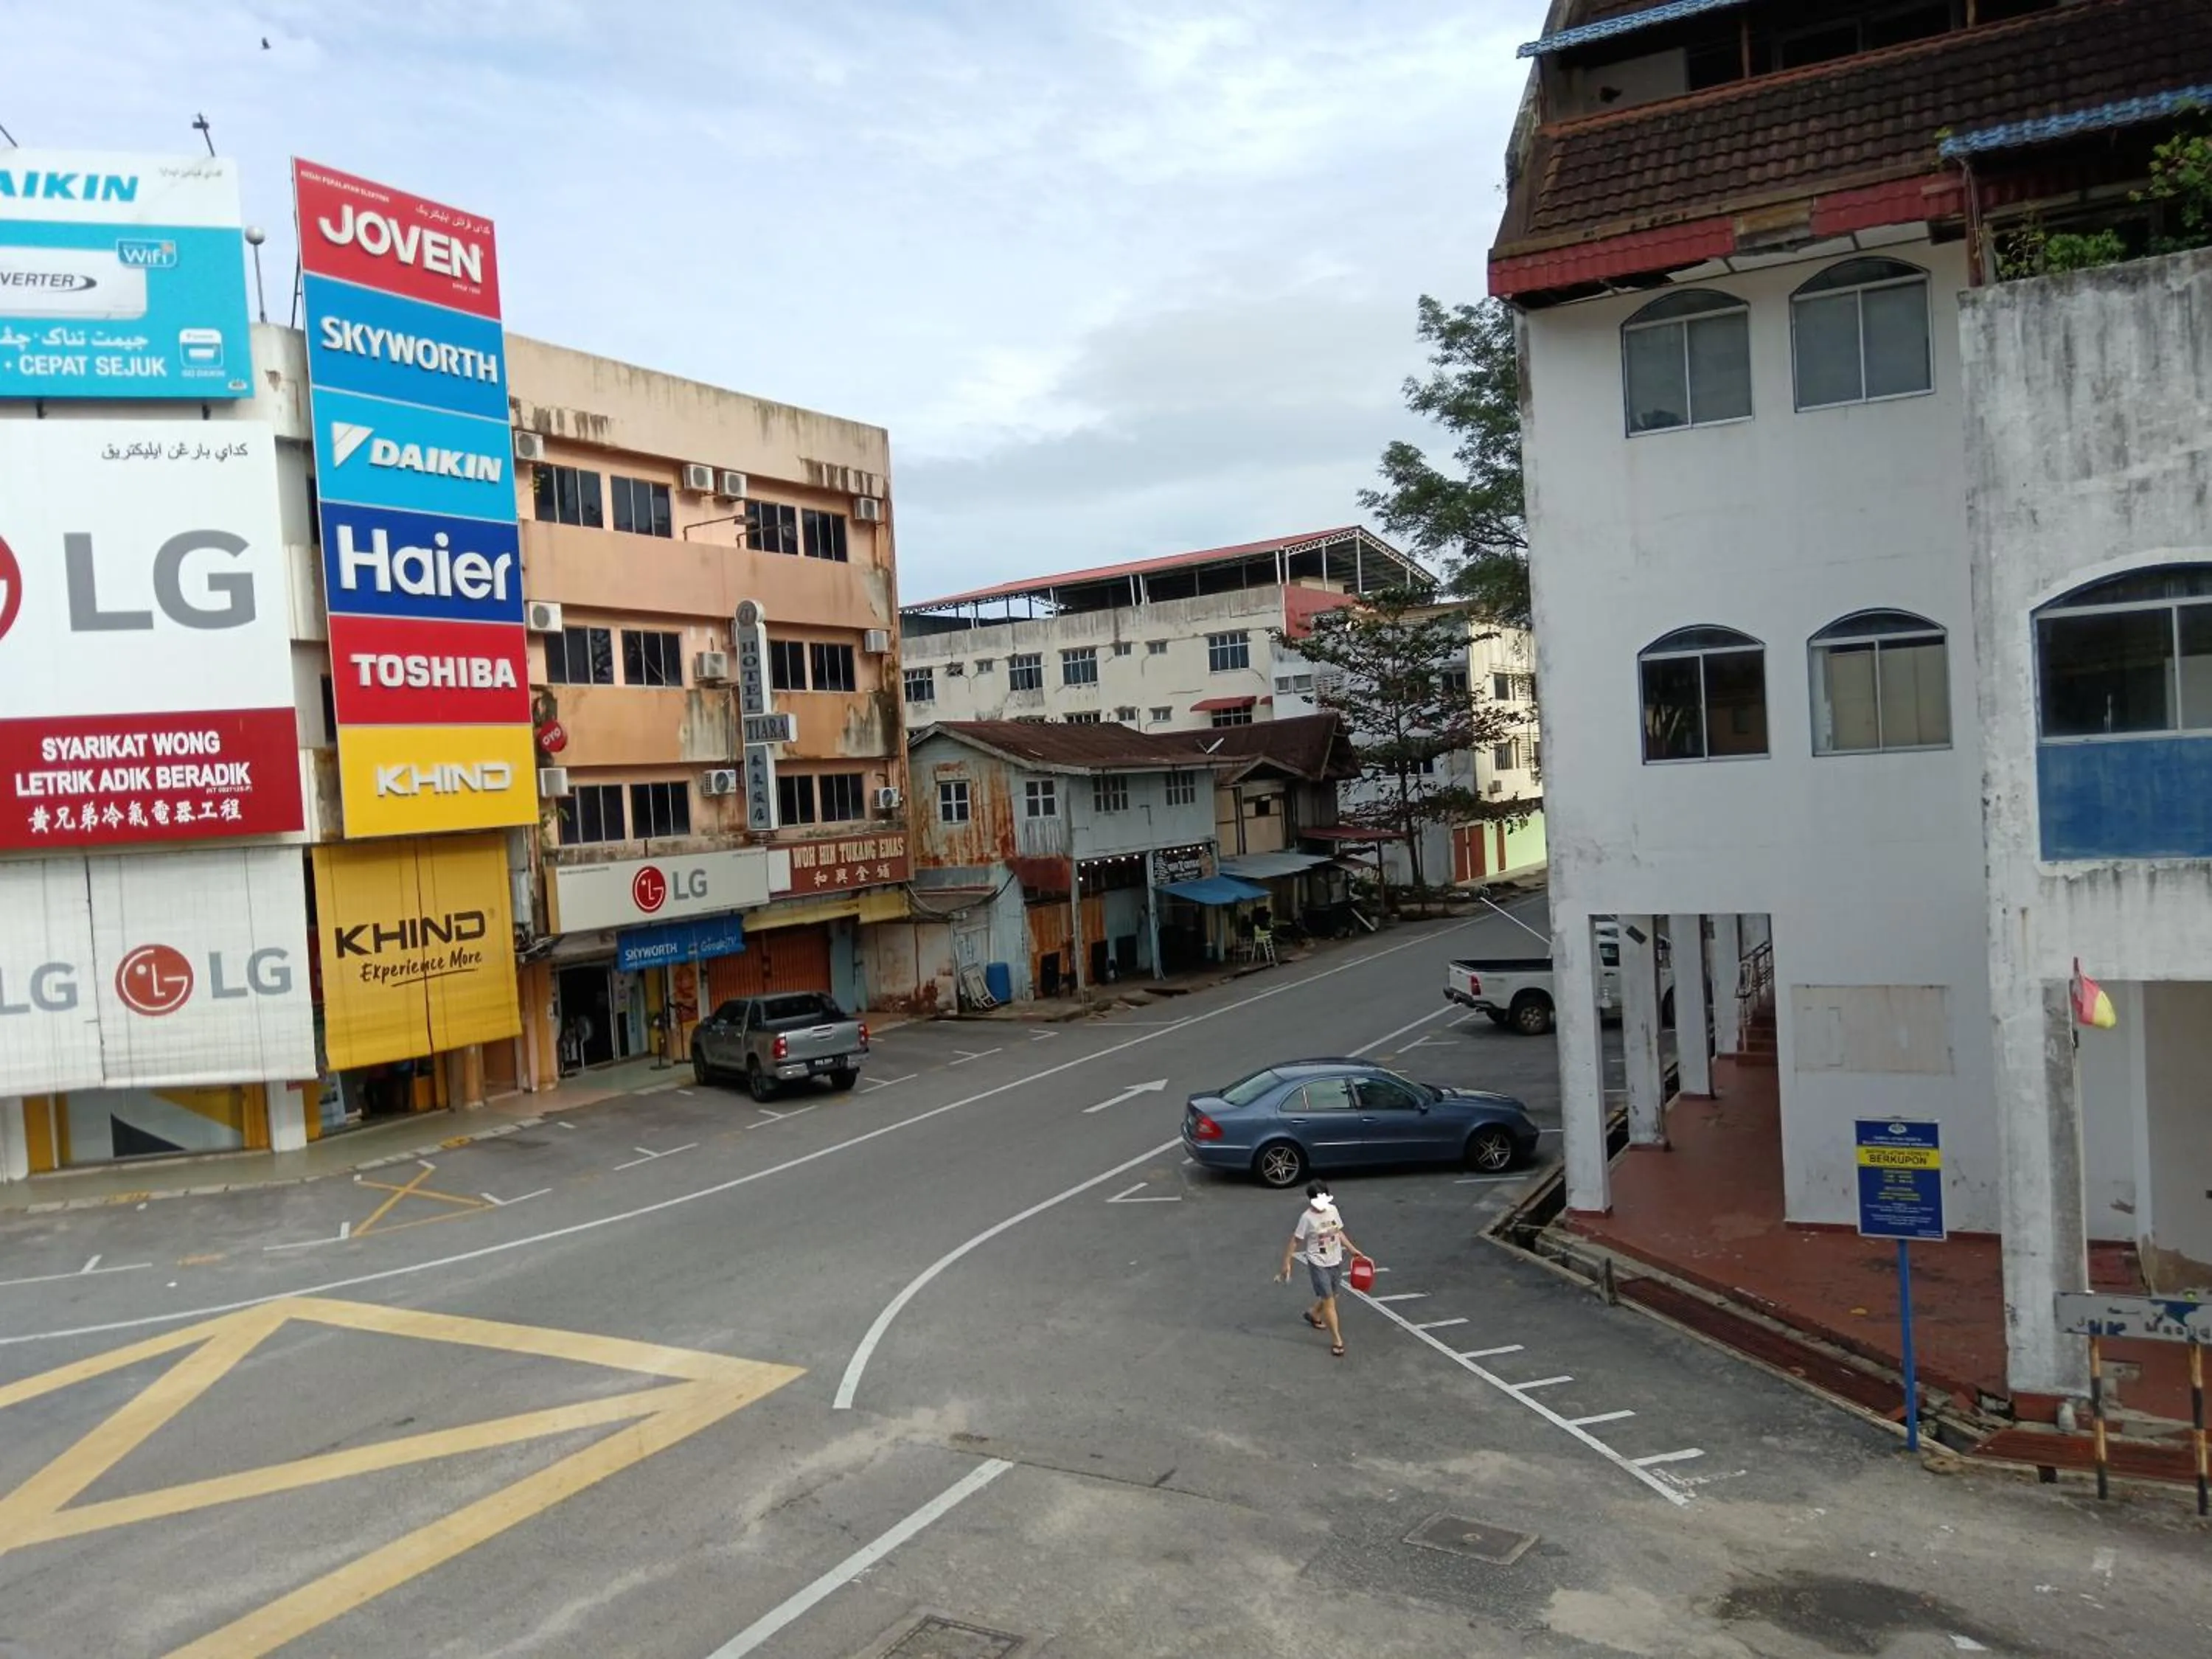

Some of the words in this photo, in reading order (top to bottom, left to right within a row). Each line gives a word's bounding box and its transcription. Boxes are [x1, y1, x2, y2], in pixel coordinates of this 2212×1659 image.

[319, 204, 482, 283] JOVEN
[19, 354, 88, 376] CEPAT
[95, 355, 168, 378] SEJUK
[320, 316, 498, 383] SKYWORTH
[369, 438, 502, 483] DAIKIN
[336, 524, 512, 600] Haier
[63, 529, 256, 632] LG
[350, 653, 517, 688] TOSHIBA
[742, 641, 761, 710] HOTEL
[41, 733, 147, 762] SYARIKAT
[152, 731, 220, 756] WONG
[542, 726, 561, 745] OYO
[745, 718, 787, 740] TIARA
[15, 769, 94, 796] LETRIK
[99, 766, 152, 793] ADIK
[156, 762, 251, 790] BERADIK
[377, 761, 513, 796] KHIND
[792, 845, 816, 869] WOH
[818, 844, 837, 865] HIN
[838, 839, 877, 863] TUKANG
[878, 837, 904, 858] EMAS
[672, 869, 708, 900] LG
[335, 910, 486, 959] KHIND
[625, 942, 678, 961] SKYWORTH
[209, 947, 293, 999] LG
[360, 957, 445, 984] Experience
[449, 947, 483, 969] More
